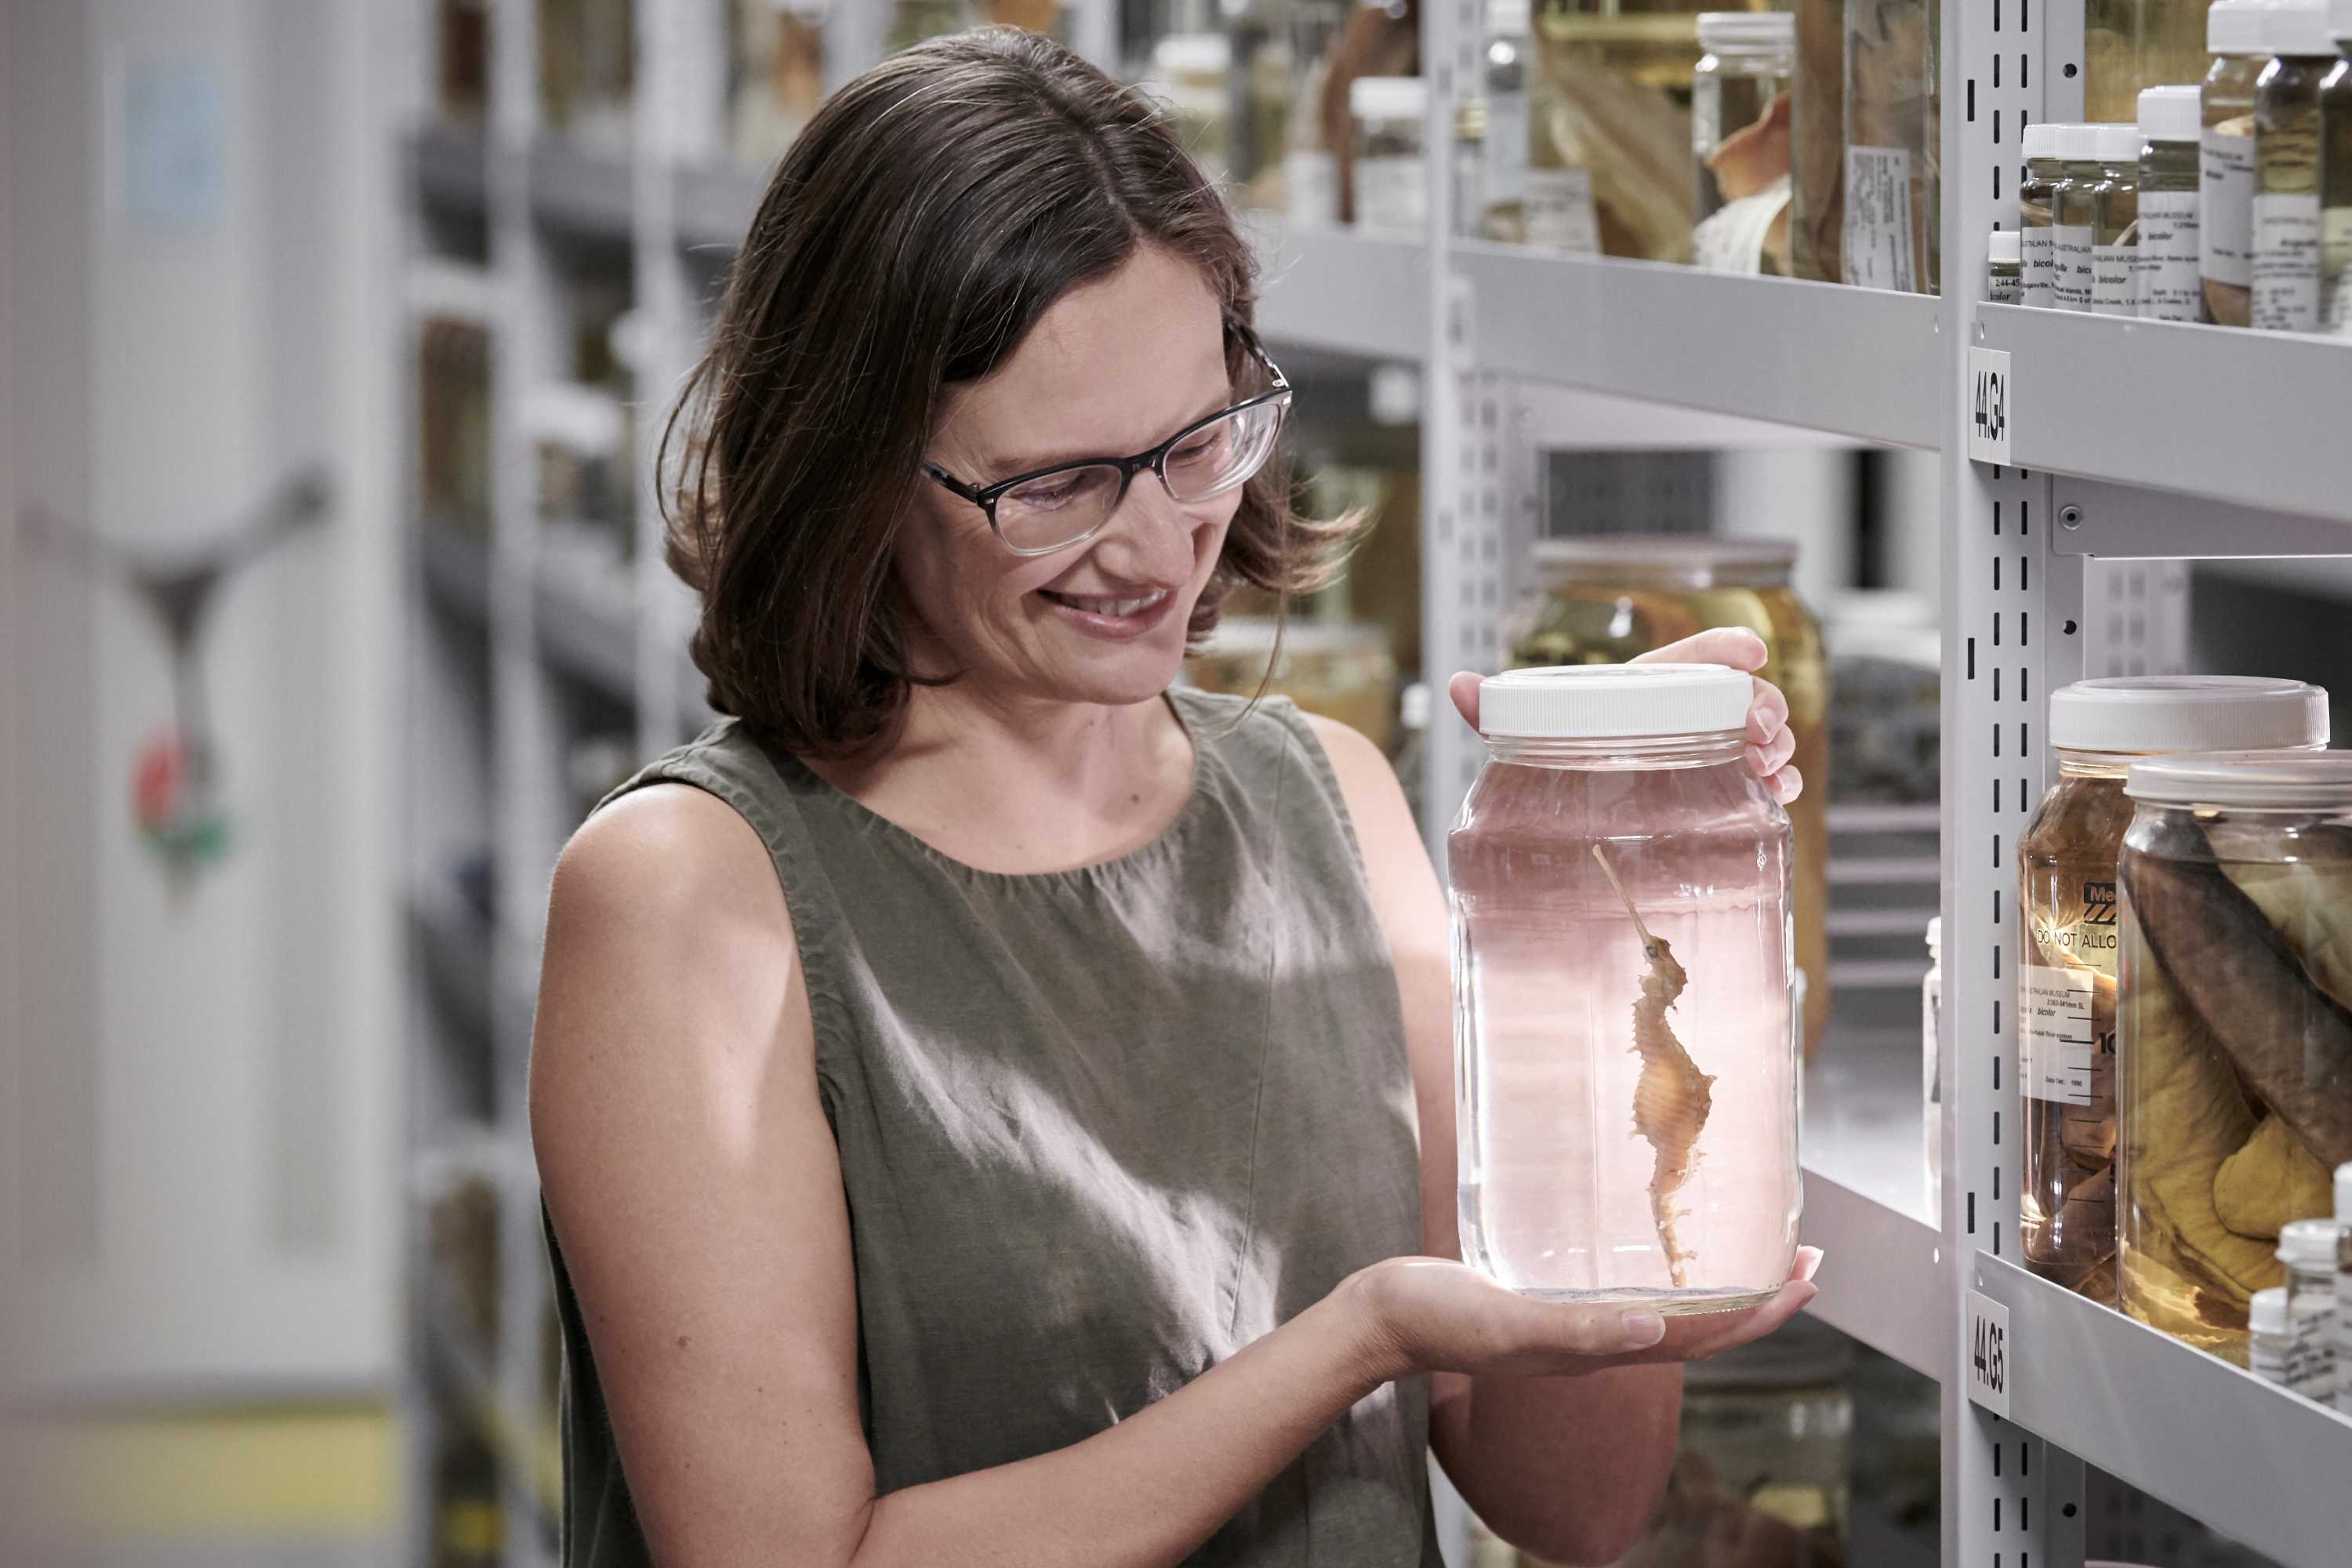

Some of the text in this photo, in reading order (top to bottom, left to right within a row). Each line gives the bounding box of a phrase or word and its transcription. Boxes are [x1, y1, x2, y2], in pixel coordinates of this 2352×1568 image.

[2099, 275, 2126, 284] bicolor
[1975, 371, 2005, 441] 44.G4
[2089, 886, 2116, 902] Me
[2038, 929, 2117, 949] DO NOT ALLO
[2037, 1006, 2056, 1017] bicolor
[1974, 1315, 2004, 1395] 44.G5
